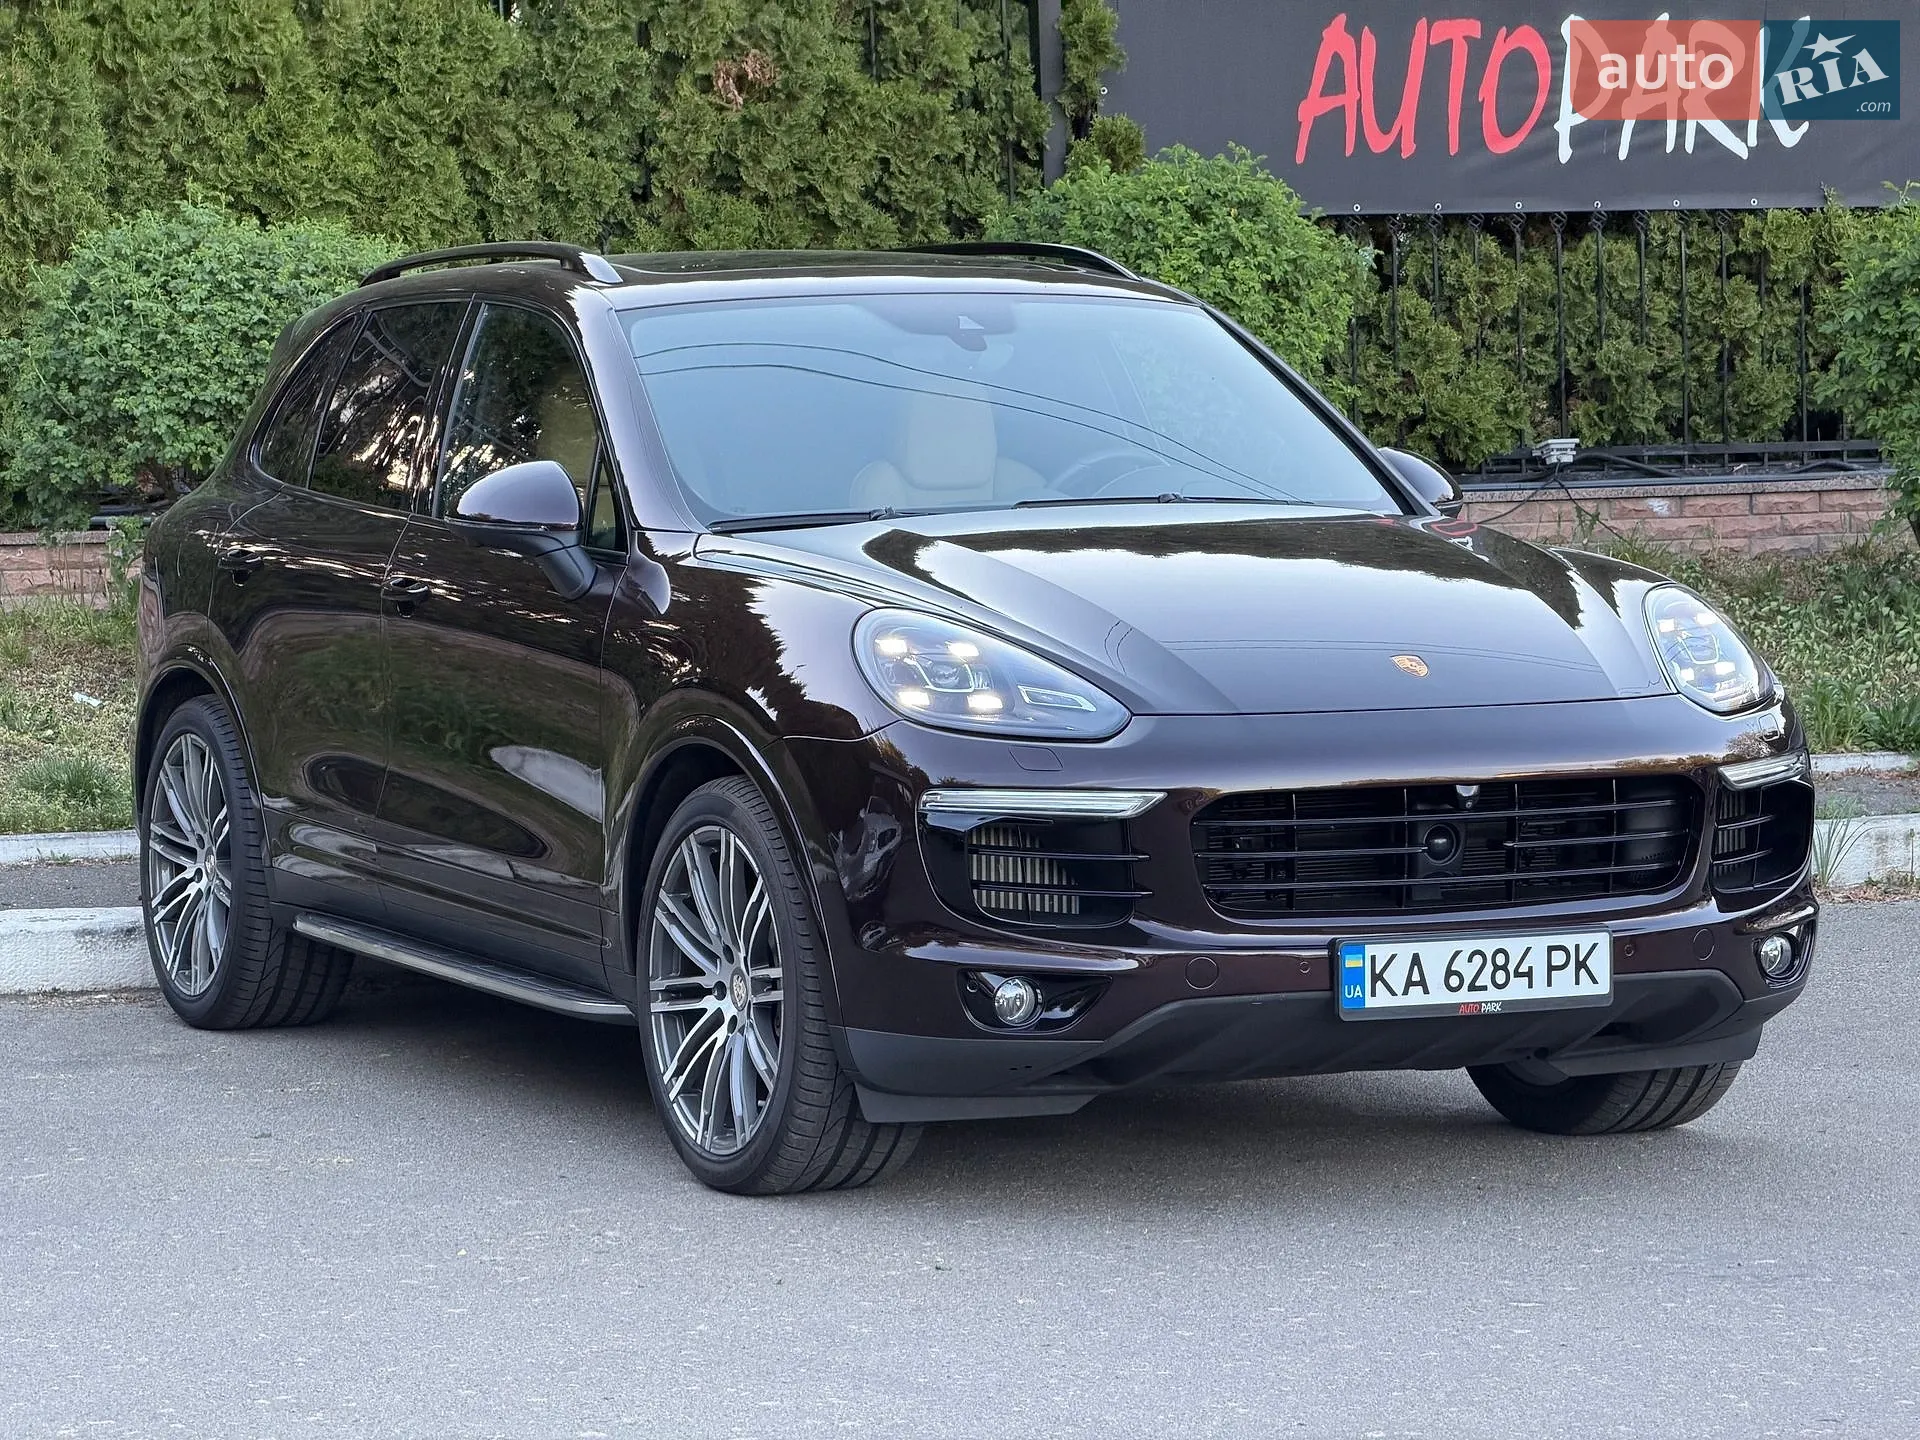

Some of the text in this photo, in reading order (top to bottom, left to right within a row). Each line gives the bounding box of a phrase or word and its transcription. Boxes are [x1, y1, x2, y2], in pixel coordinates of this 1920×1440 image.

[1370, 942, 1600, 998] KA 6284 PK
[1345, 985, 1363, 999] UA
[1459, 1001, 1502, 1014] AUTO PARK
